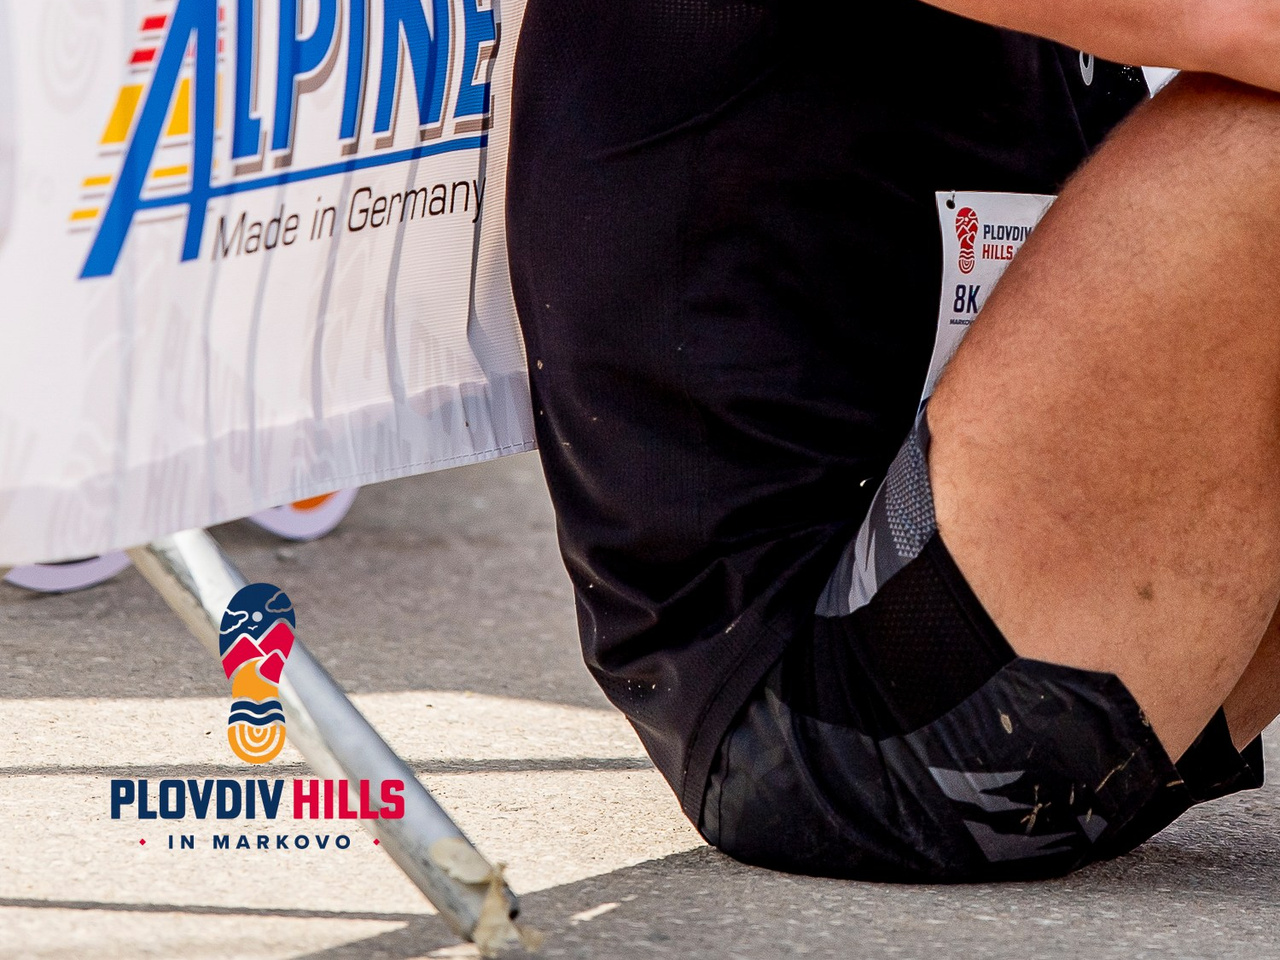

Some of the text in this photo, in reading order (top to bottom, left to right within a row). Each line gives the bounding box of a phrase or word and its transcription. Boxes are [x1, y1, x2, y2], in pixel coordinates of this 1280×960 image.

[211, 177, 486, 261] Made in Germany
[982, 244, 1014, 260] HILLS
[953, 284, 981, 314] 8K
